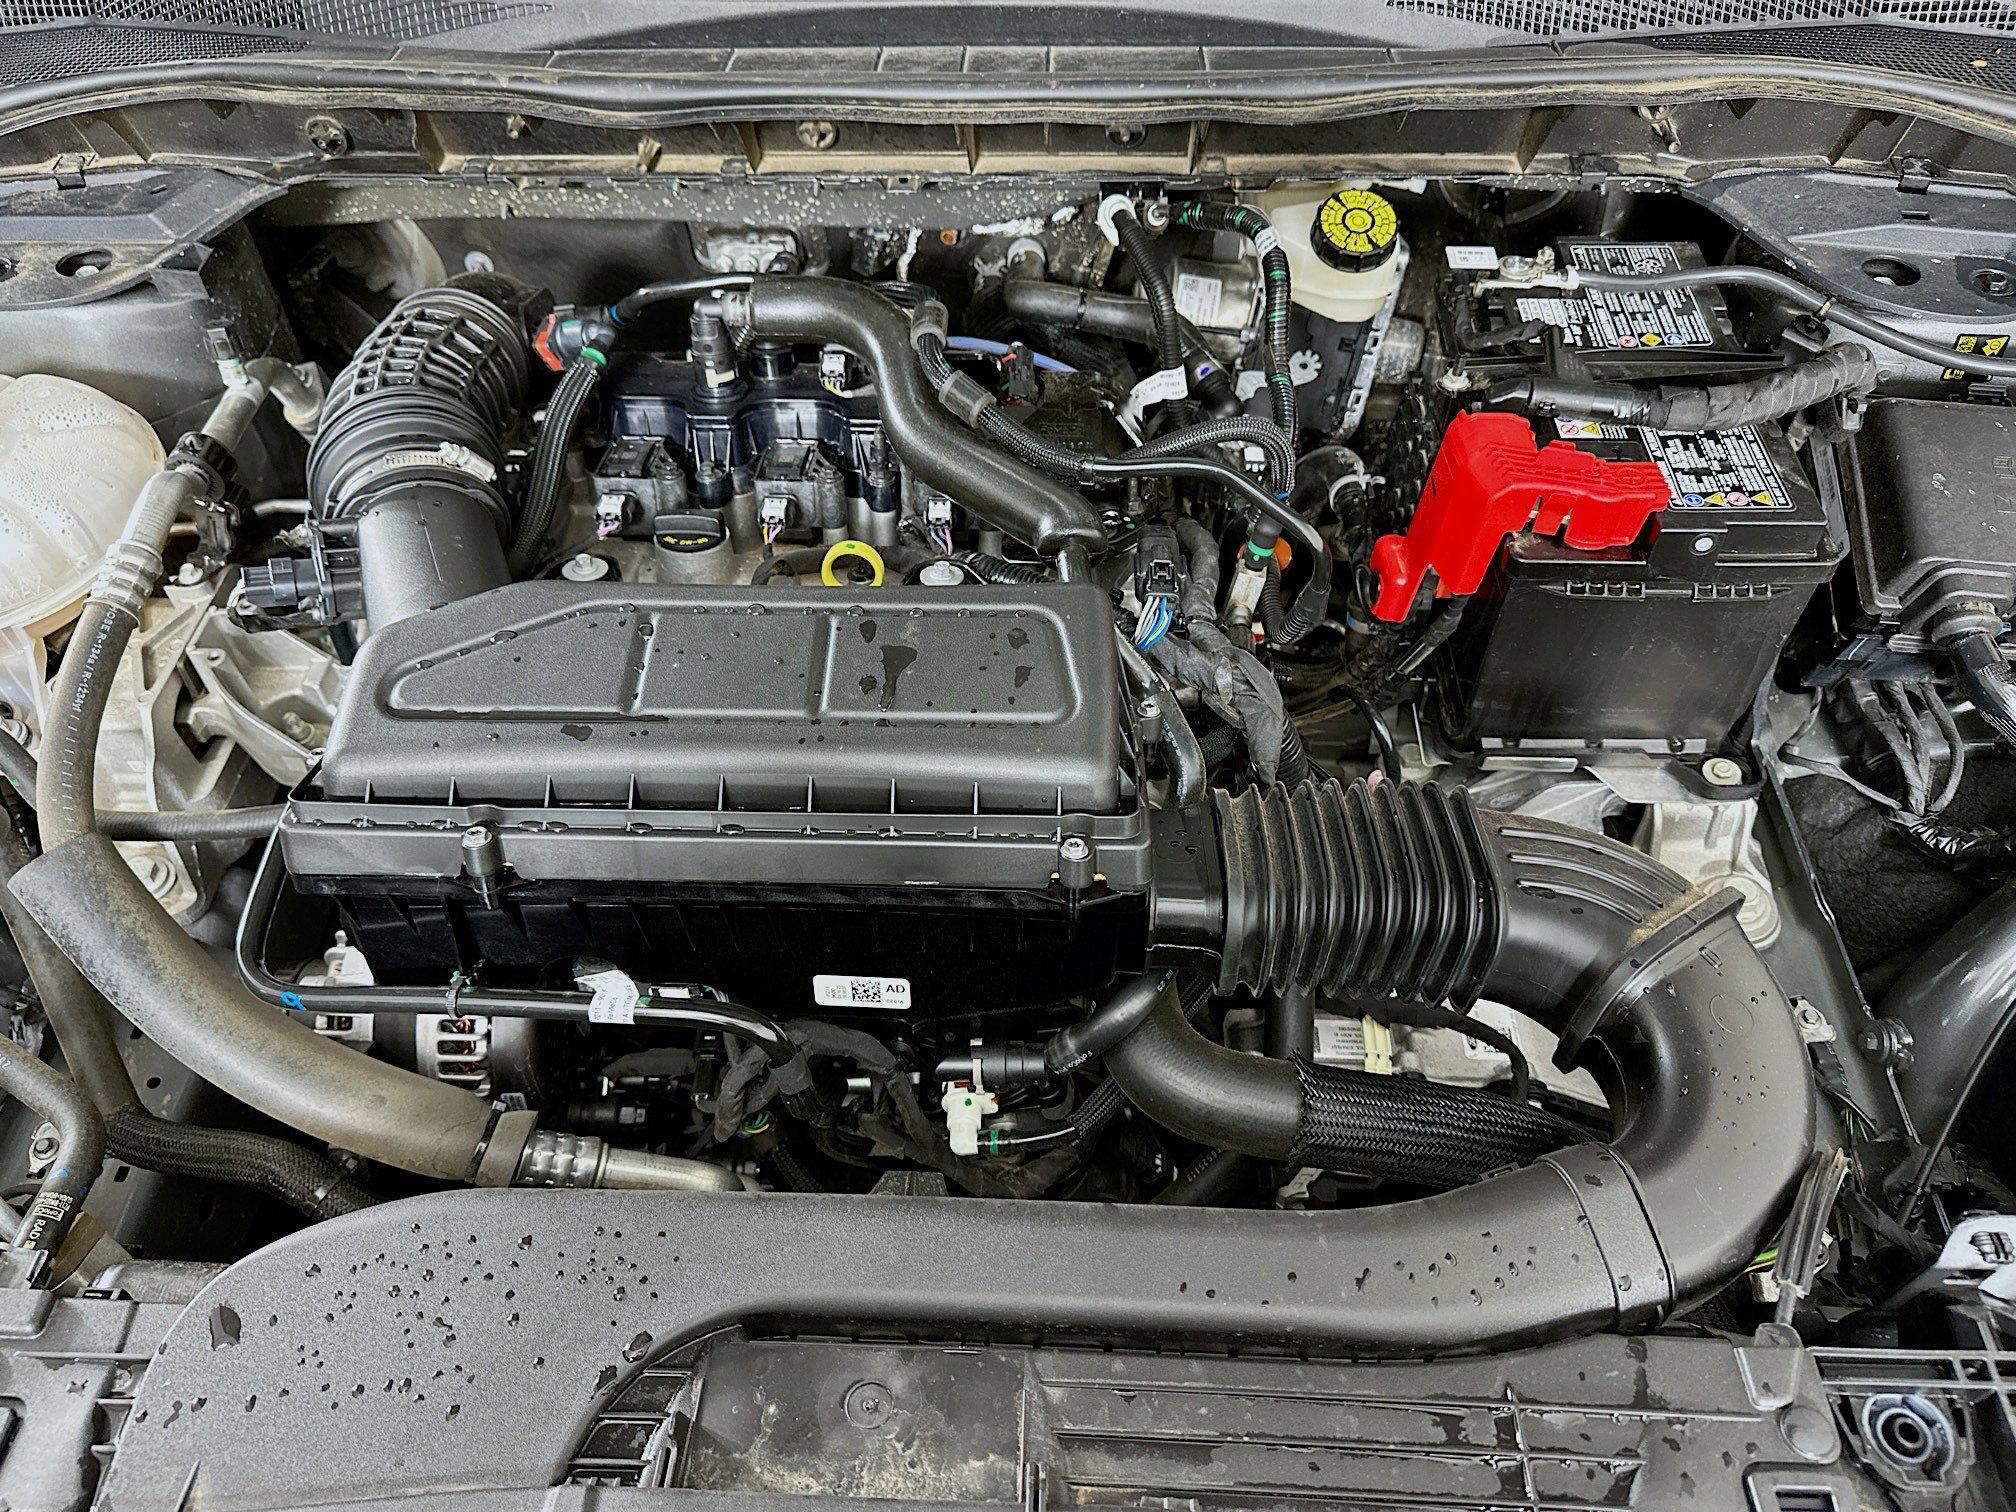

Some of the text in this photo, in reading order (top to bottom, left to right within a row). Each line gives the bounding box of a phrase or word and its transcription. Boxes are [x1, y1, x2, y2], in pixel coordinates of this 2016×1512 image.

[101, 605, 118, 632] HOSE
[87, 631, 108, 665] R-134a
[71, 671, 93, 713] R-1234yf
[886, 984, 905, 993] AD
[29, 1218, 47, 1240] RAD
